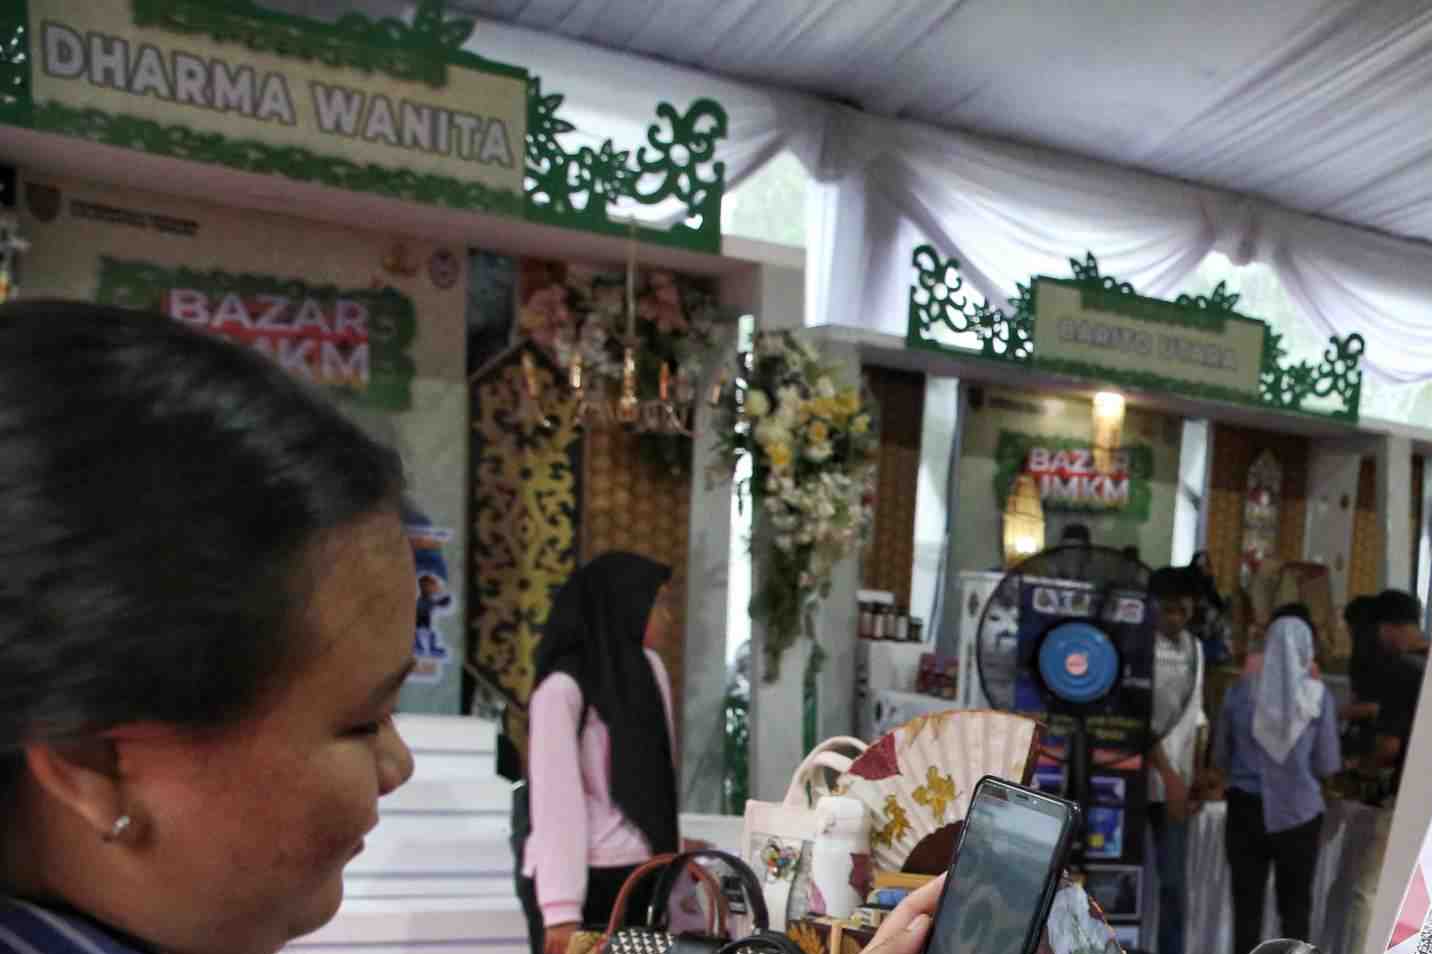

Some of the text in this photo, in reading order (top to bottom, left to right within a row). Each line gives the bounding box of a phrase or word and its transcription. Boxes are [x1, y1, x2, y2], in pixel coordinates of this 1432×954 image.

[42, 23, 514, 169] DHARMA WANITA
[169, 288, 370, 335] BAZAR
